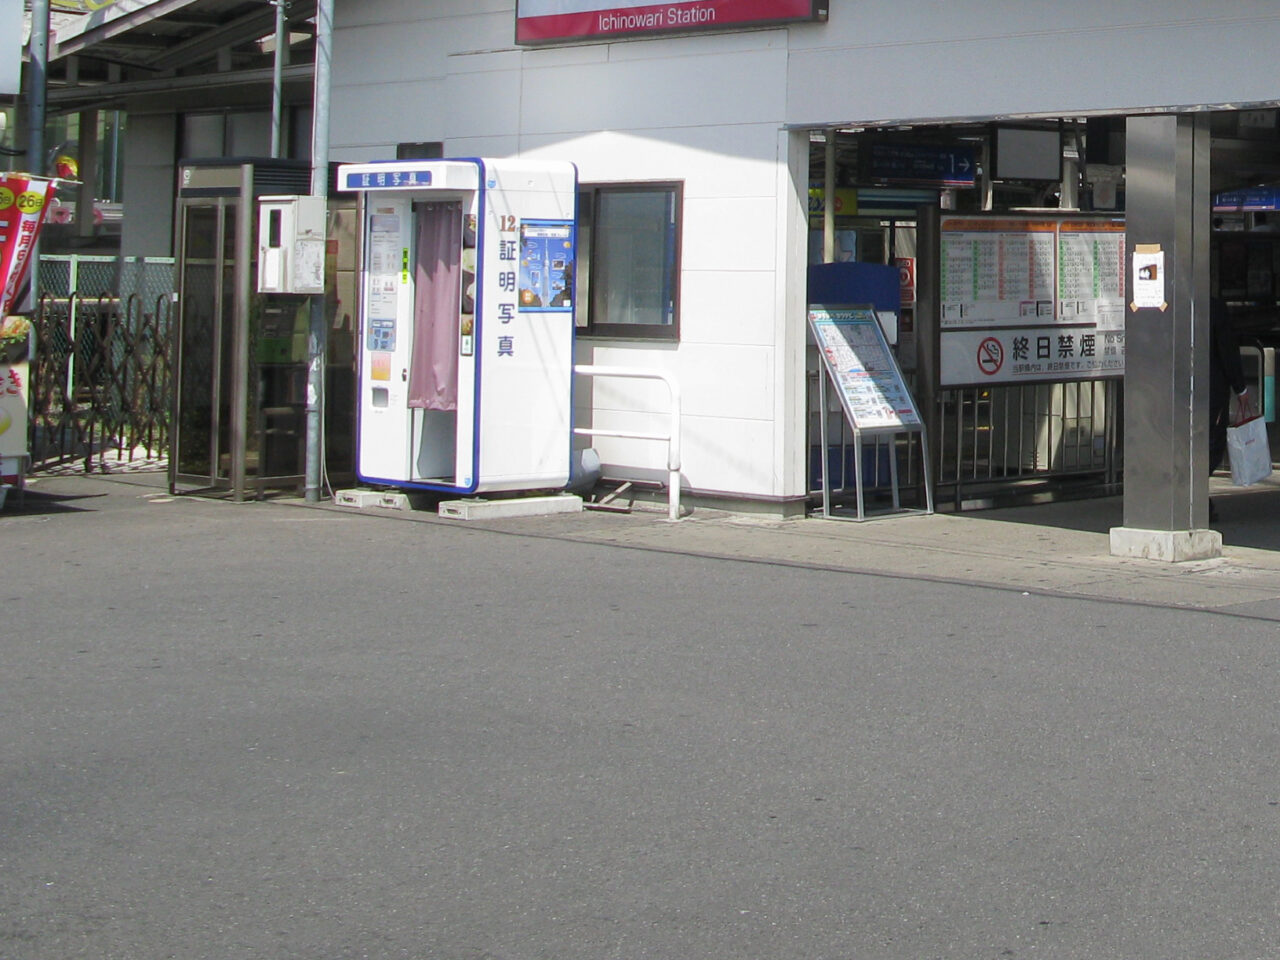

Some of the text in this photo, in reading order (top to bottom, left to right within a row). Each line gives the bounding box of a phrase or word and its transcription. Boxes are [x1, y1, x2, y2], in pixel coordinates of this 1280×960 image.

[598, 5, 716, 31] Ichinowari Station
[496, 239, 517, 358] 証明写真
[1012, 334, 1096, 361] 終日禁煙
